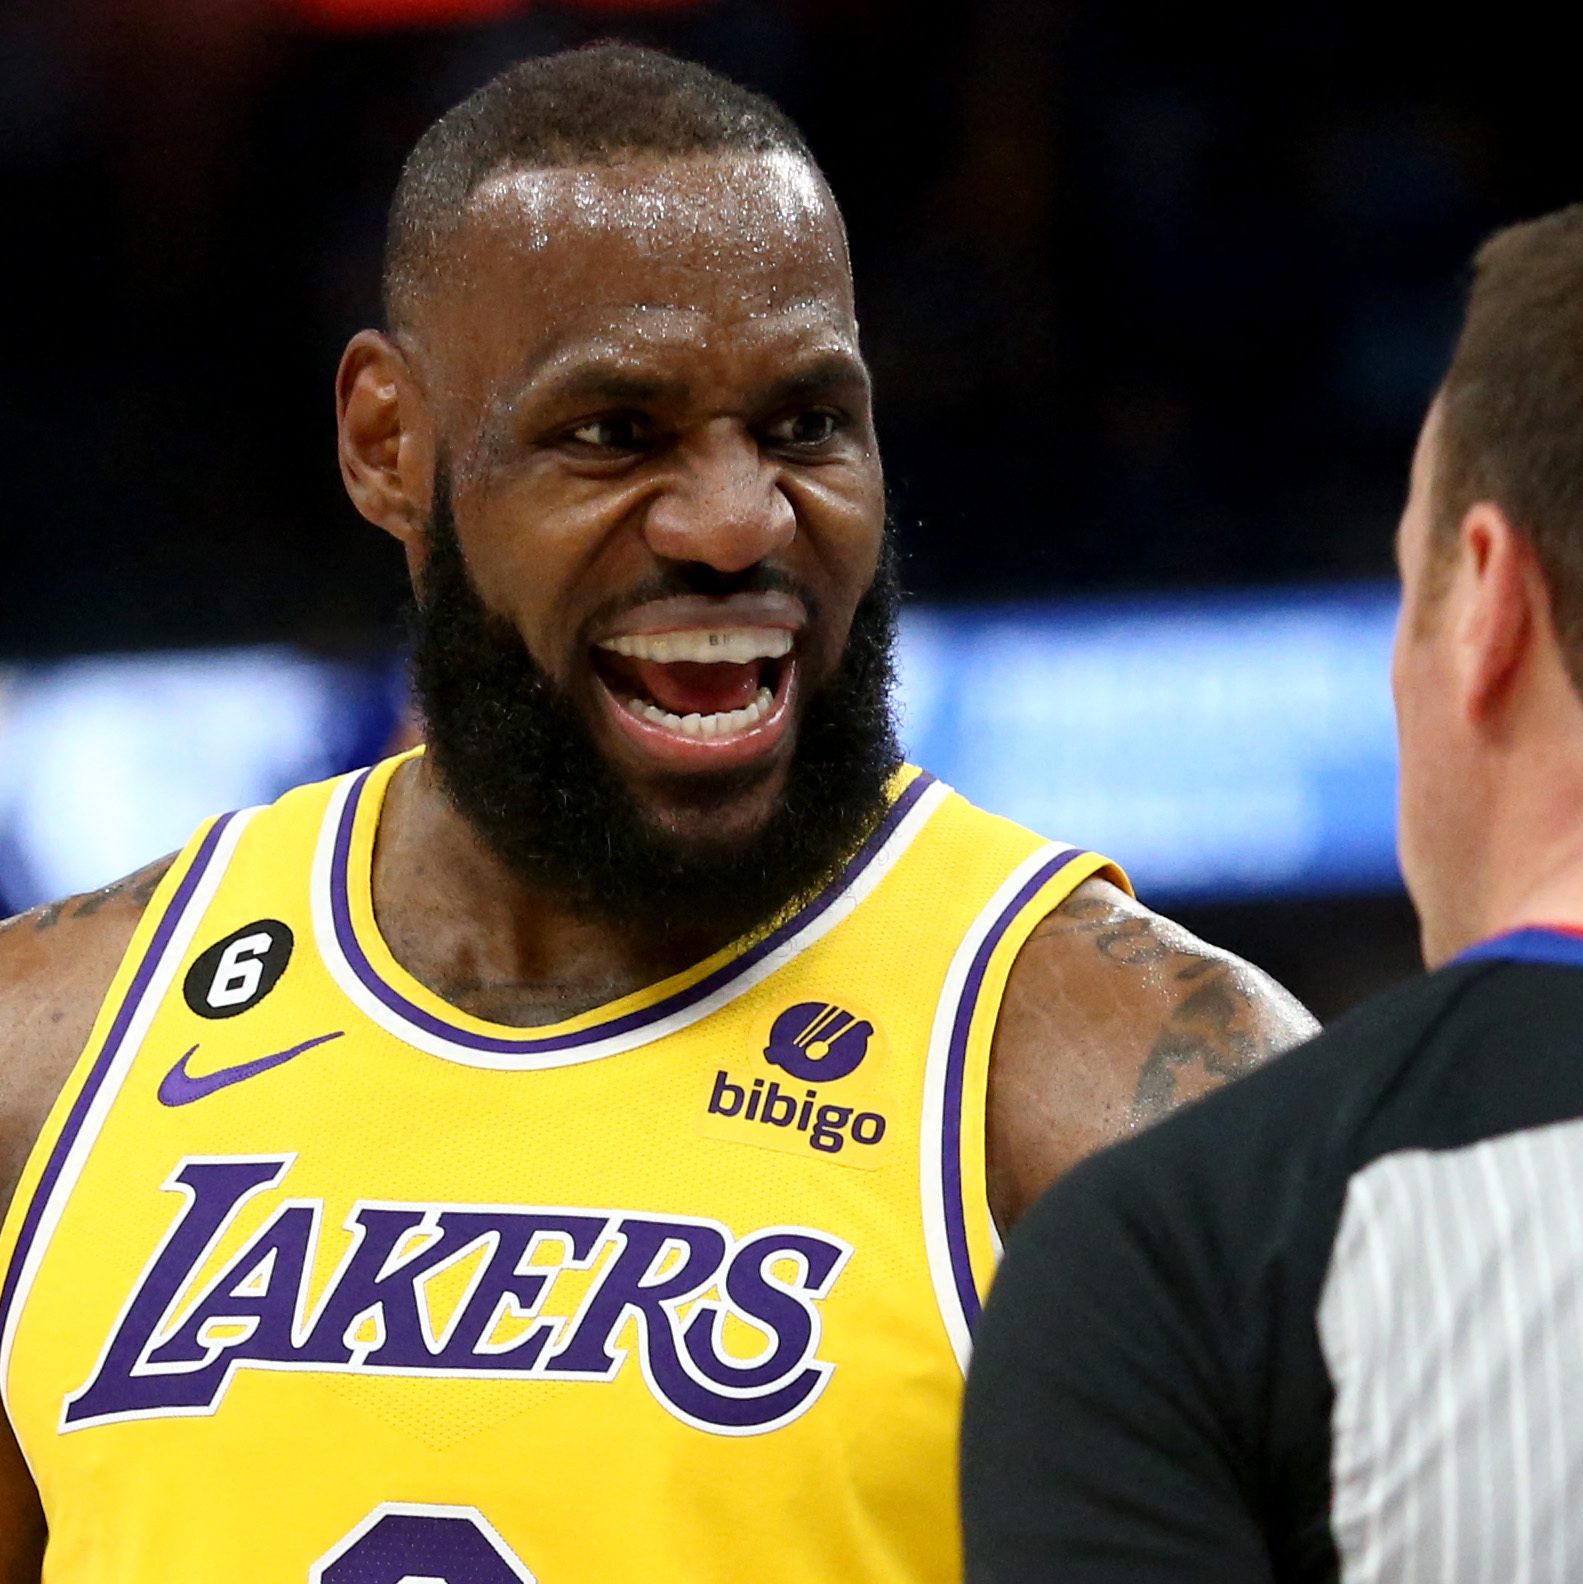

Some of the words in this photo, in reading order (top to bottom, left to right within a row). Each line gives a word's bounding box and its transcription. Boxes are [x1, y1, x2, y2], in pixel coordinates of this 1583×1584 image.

[205, 931, 273, 1008] 6
[707, 1069, 887, 1154] bibigo
[58, 1152, 854, 1436] LAKERS
